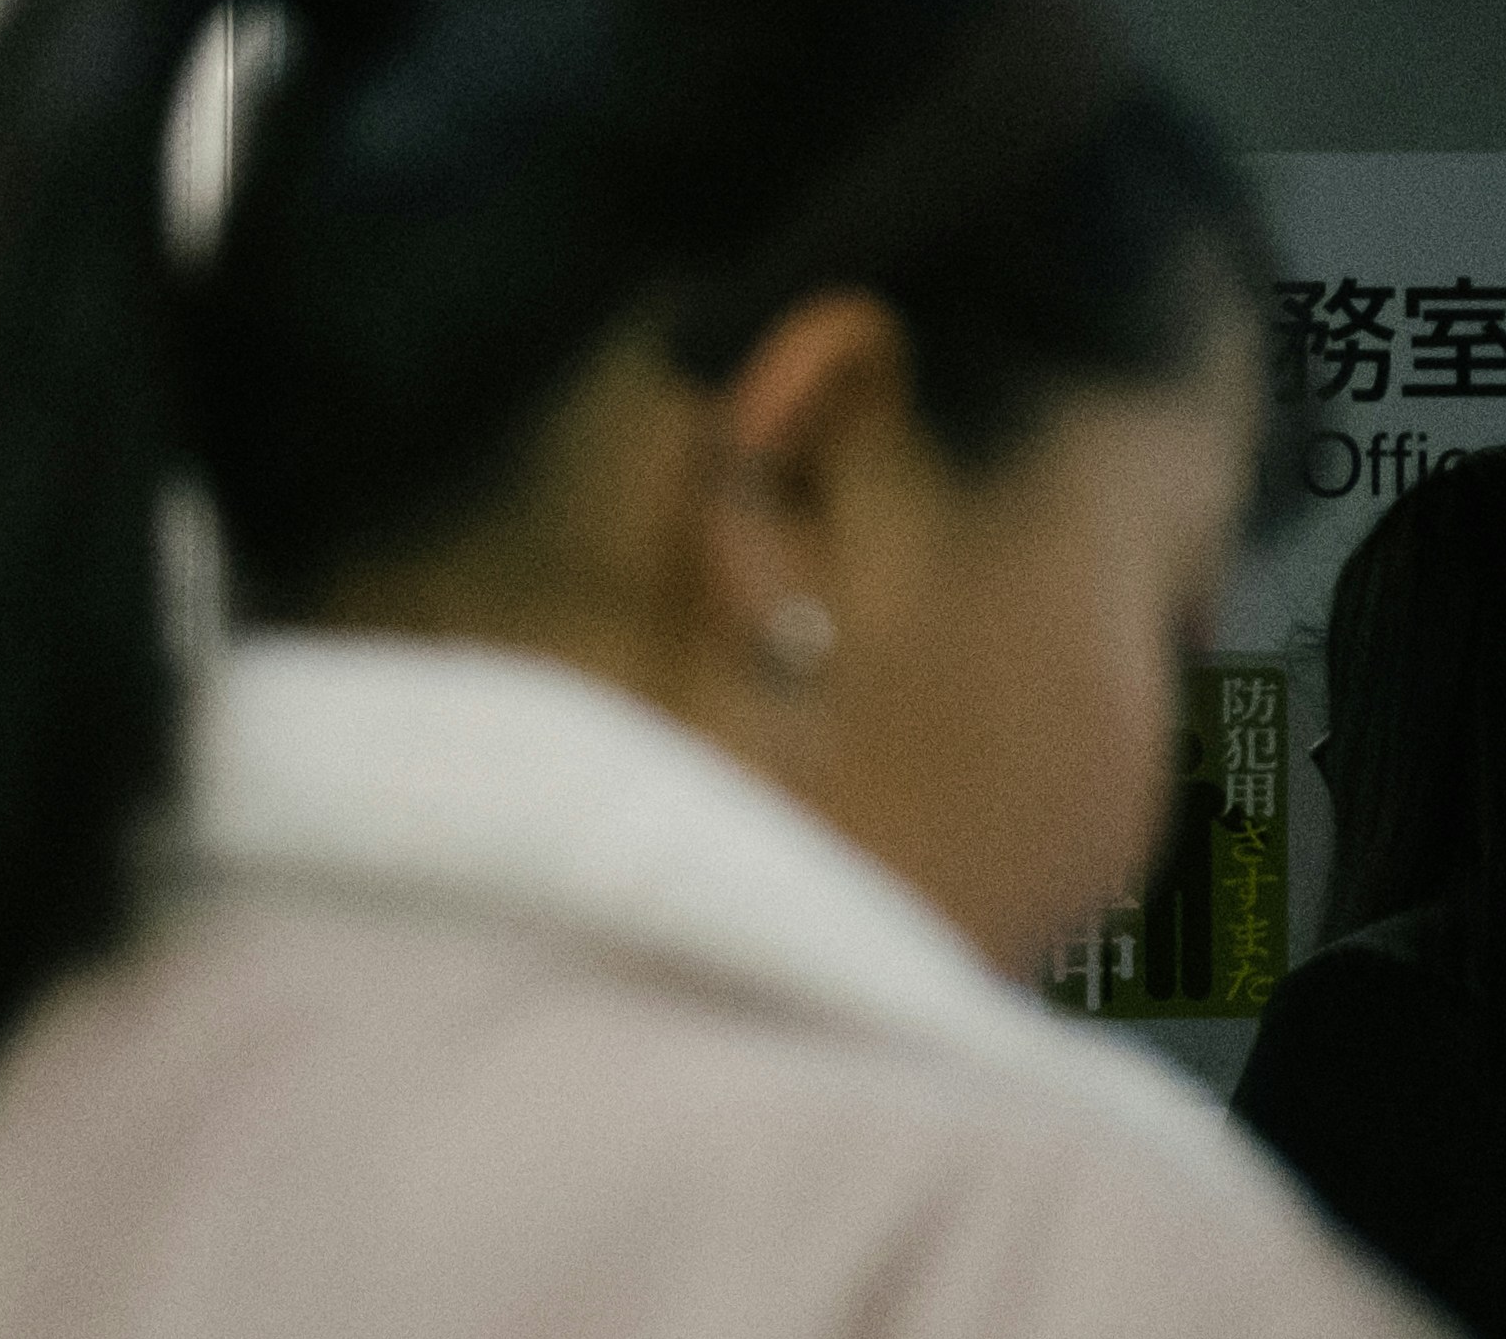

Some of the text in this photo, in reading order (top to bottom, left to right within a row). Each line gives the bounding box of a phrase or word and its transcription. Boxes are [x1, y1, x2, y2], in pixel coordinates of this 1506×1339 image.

[1221, 676, 1280, 1003] 防犯用さすまた
